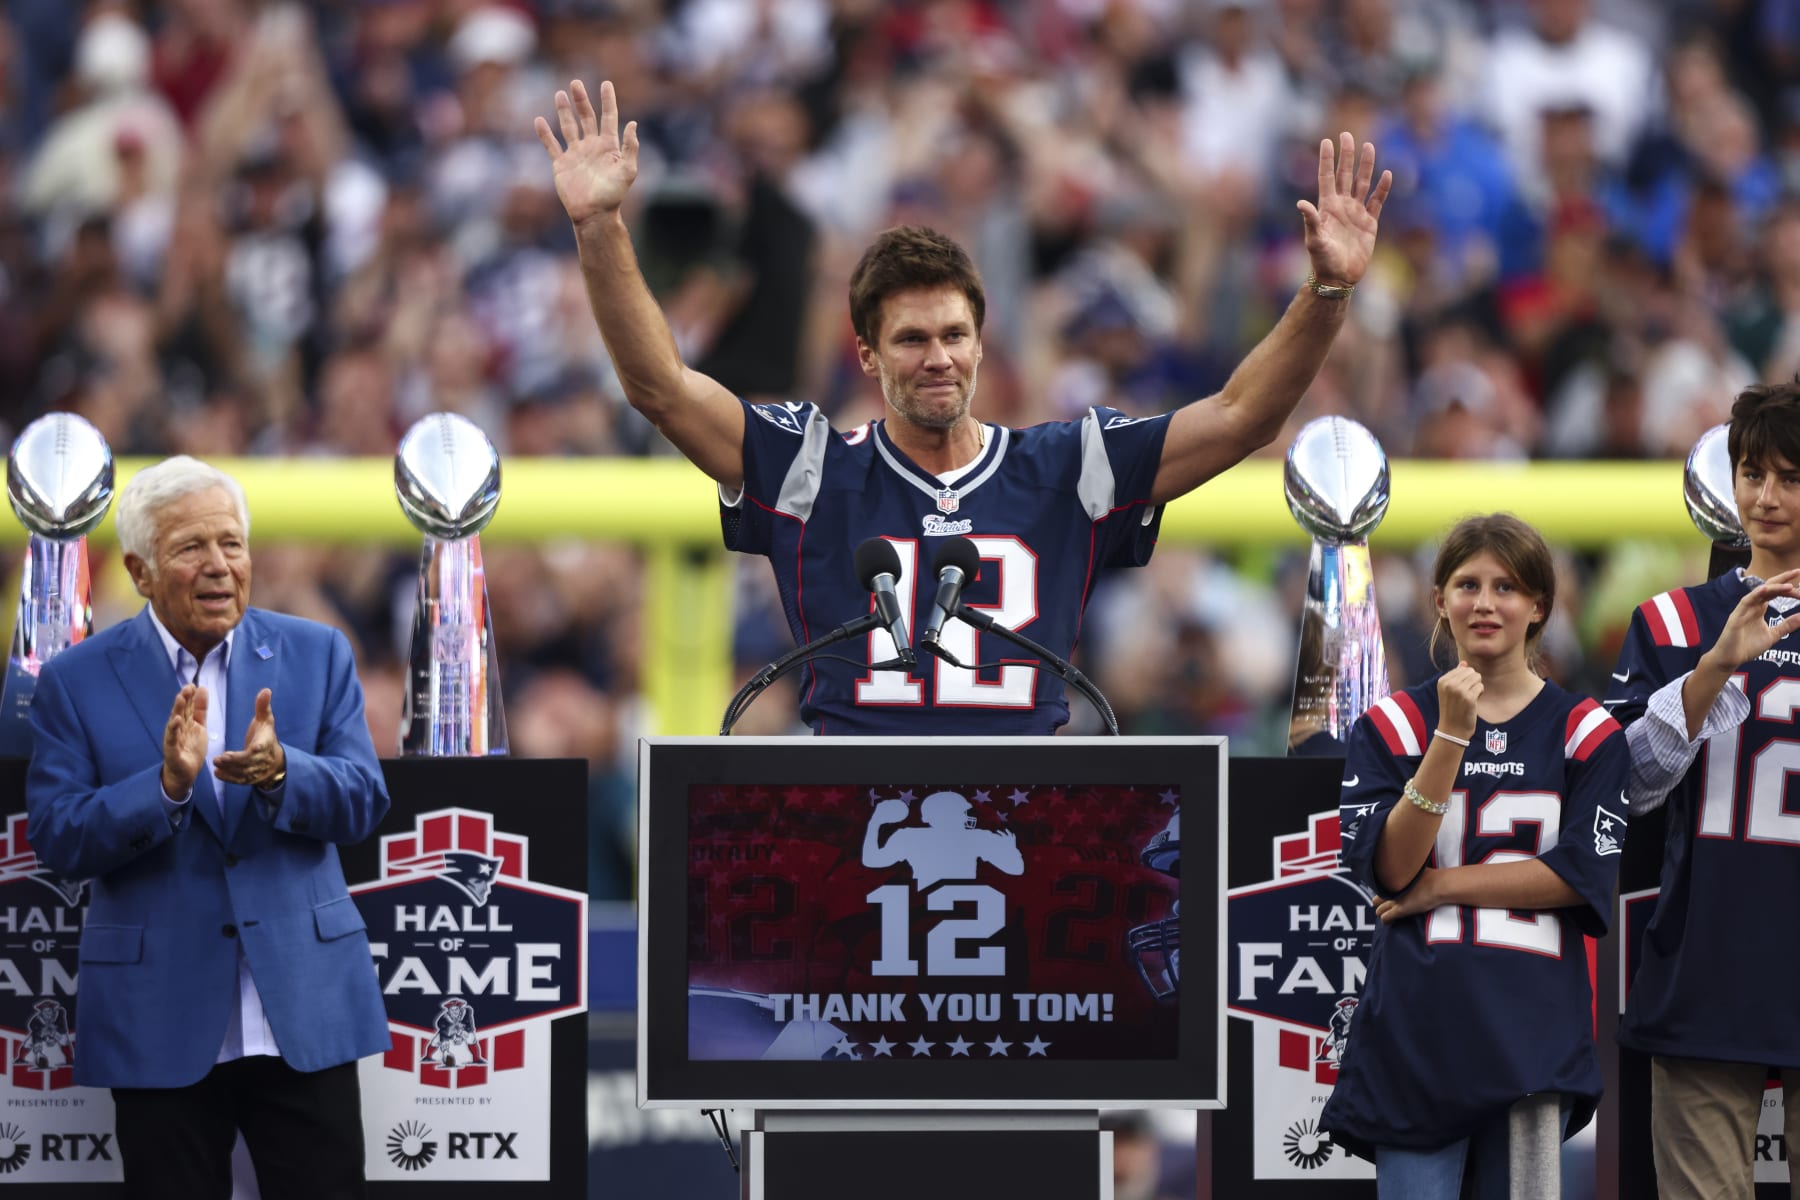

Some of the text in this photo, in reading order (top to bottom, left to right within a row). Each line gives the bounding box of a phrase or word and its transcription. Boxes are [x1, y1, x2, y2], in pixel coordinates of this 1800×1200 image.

[941, 497, 957, 510] NFL
[855, 535, 1040, 710] 12
[1756, 649, 1800, 667] TRIOT
[1489, 740, 1504, 750] NFL
[1464, 762, 1525, 776] PATRIOTS
[1426, 789, 1562, 960] 12
[0, 906, 88, 933] HAL
[395, 905, 513, 932] HALL
[866, 885, 1006, 976] 12
[1289, 904, 1375, 932] HAL
[32, 940, 56, 953] OF
[439, 938, 465, 951] OF
[1333, 937, 1358, 951] OF
[768, 994, 1115, 1022] THANK YOU TOM!
[8, 1099, 69, 1107] PRESENTED
[415, 1097, 492, 1105] PRESENTED BY
[41, 1133, 113, 1161] RTX
[448, 1132, 519, 1159] RTX
[1754, 1134, 1788, 1161] RT
